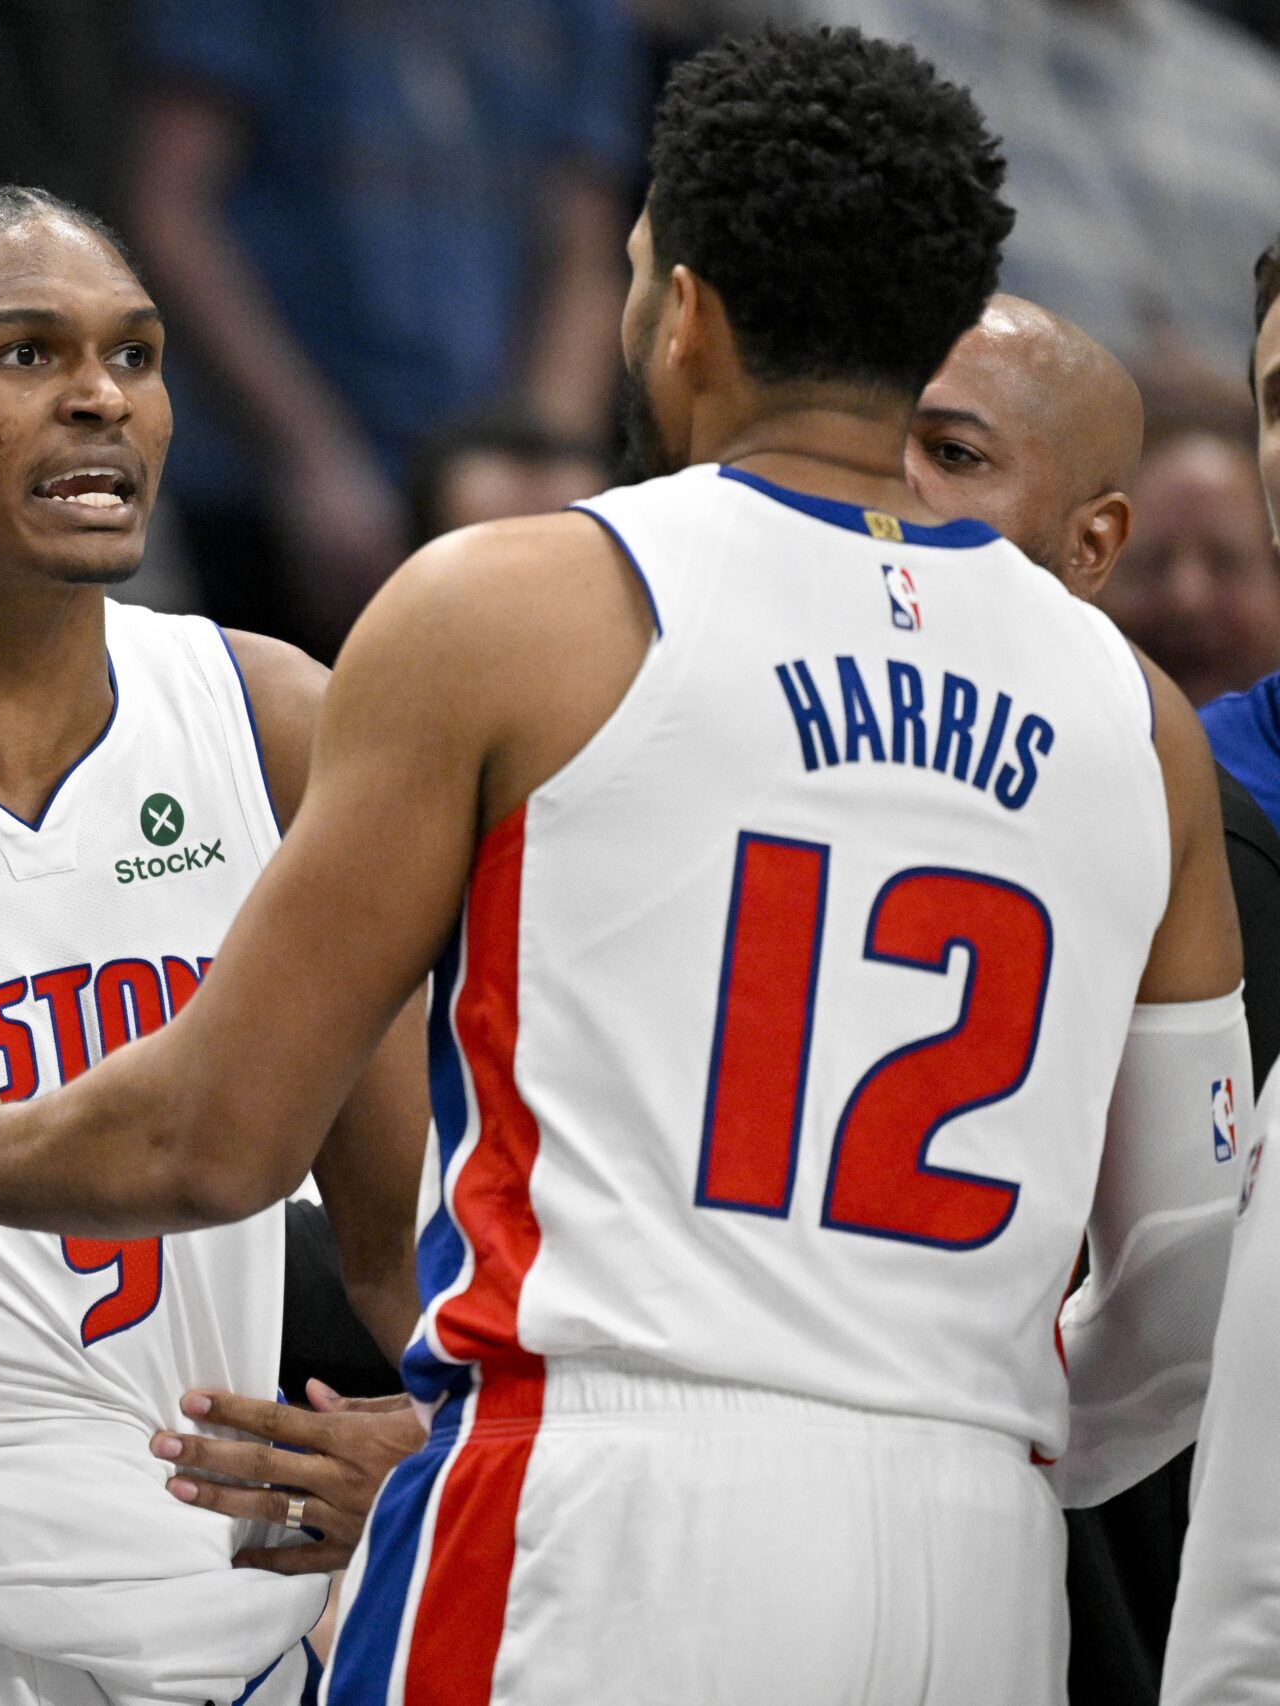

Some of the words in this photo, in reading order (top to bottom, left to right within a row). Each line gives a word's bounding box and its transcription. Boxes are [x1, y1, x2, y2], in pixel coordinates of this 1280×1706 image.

[775, 655, 1055, 811] HARRIS
[114, 838, 226, 884] StockX
[694, 830, 1054, 1253] 12
